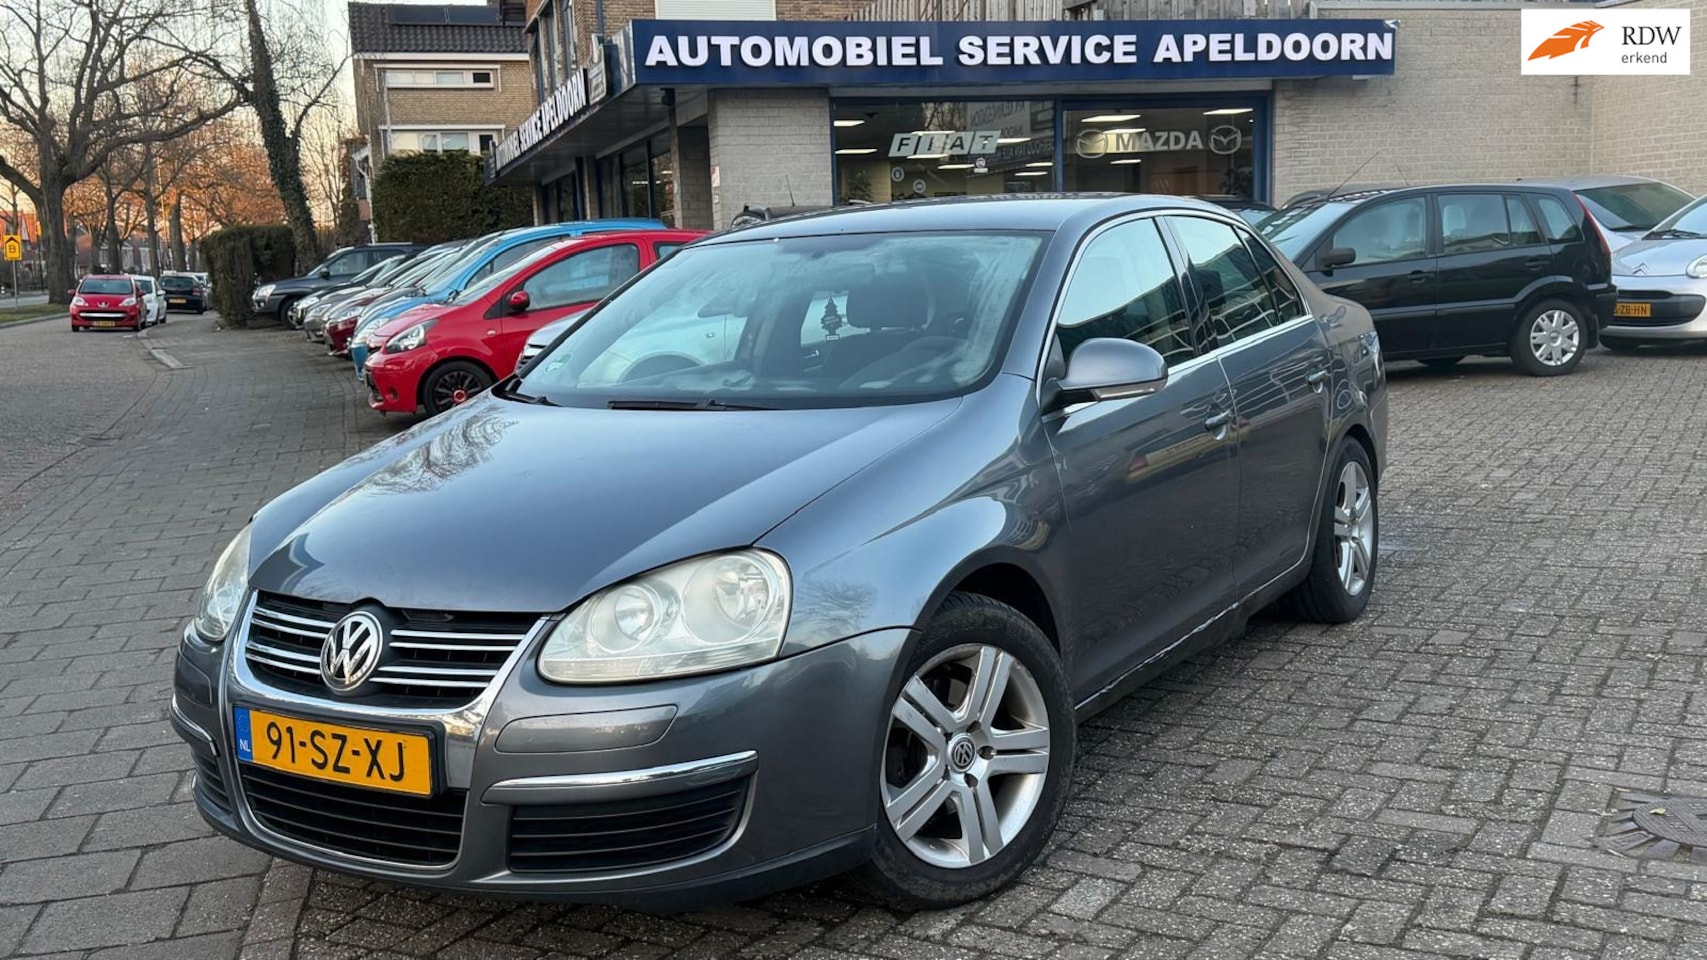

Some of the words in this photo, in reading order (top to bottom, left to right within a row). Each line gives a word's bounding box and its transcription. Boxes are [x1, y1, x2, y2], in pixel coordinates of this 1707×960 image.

[645, 35, 943, 66] AUTOMOBIEL
[958, 34, 1138, 65] SERVICE
[1153, 32, 1393, 62] APELDOORN
[541, 67, 587, 137] APELDOORN
[897, 134, 993, 153] FIAT
[1115, 130, 1204, 151] MAZDA
[239, 739, 251, 752] NL
[266, 721, 405, 782] 91-SZ-XJ
